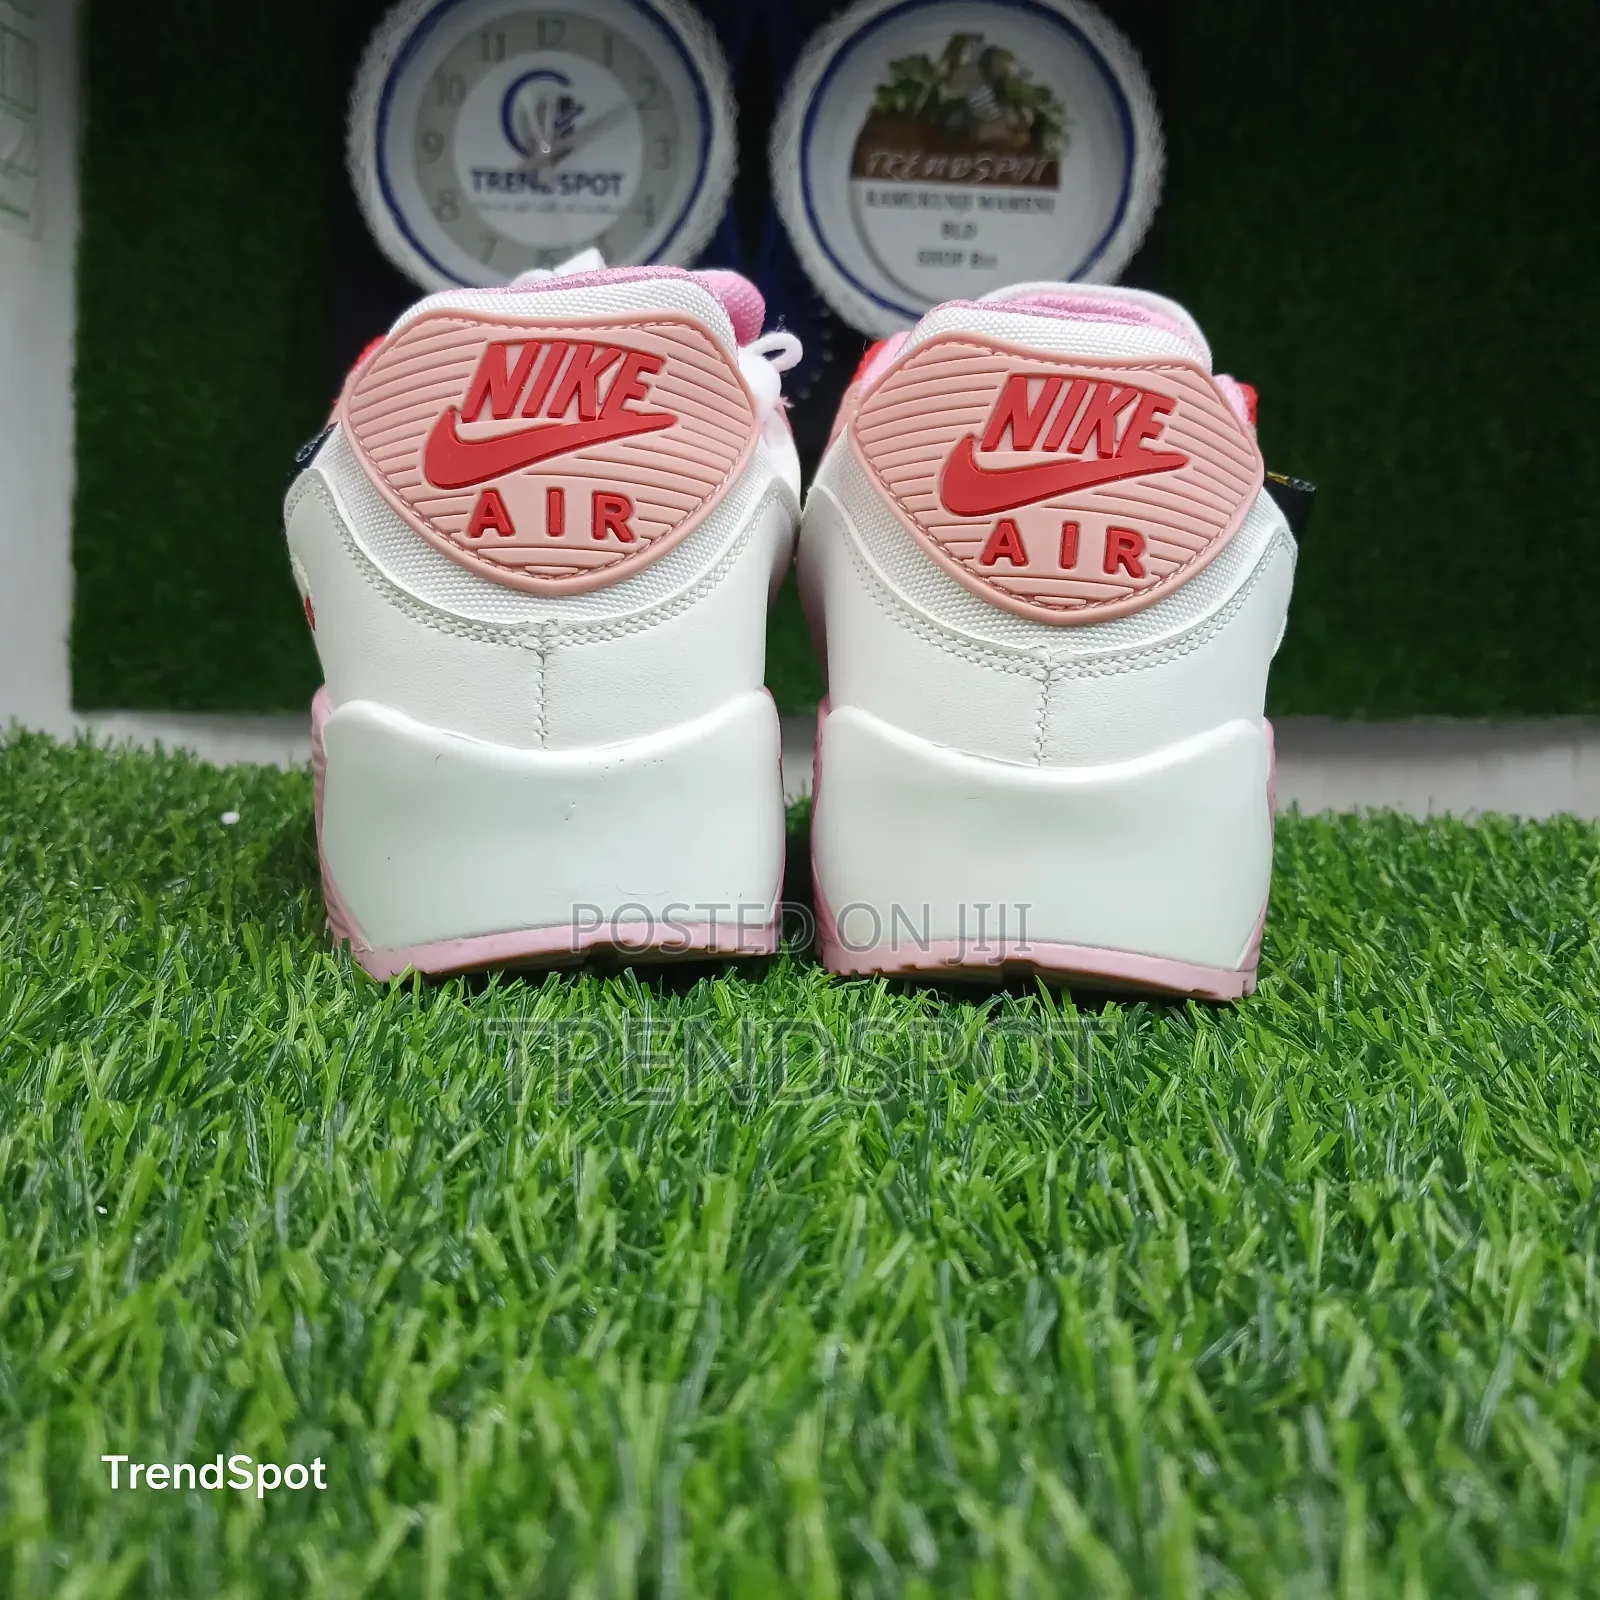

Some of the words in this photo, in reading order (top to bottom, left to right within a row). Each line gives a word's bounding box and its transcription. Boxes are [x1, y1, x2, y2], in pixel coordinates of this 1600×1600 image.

[481, 33, 506, 62] 11
[537, 17, 566, 49] 12
[602, 32, 614, 68] 1
[435, 70, 466, 107] 10
[637, 73, 658, 110] 2
[421, 129, 445, 163] 9
[653, 135, 672, 170] 3
[471, 167, 624, 197] TRENSPOT
[435, 189, 461, 222] 8
[635, 195, 657, 227] 4
[460, 338, 666, 422] NIKE
[980, 373, 1177, 459] NIKE
[466, 489, 636, 543] AIR
[979, 520, 1146, 579] AIR
